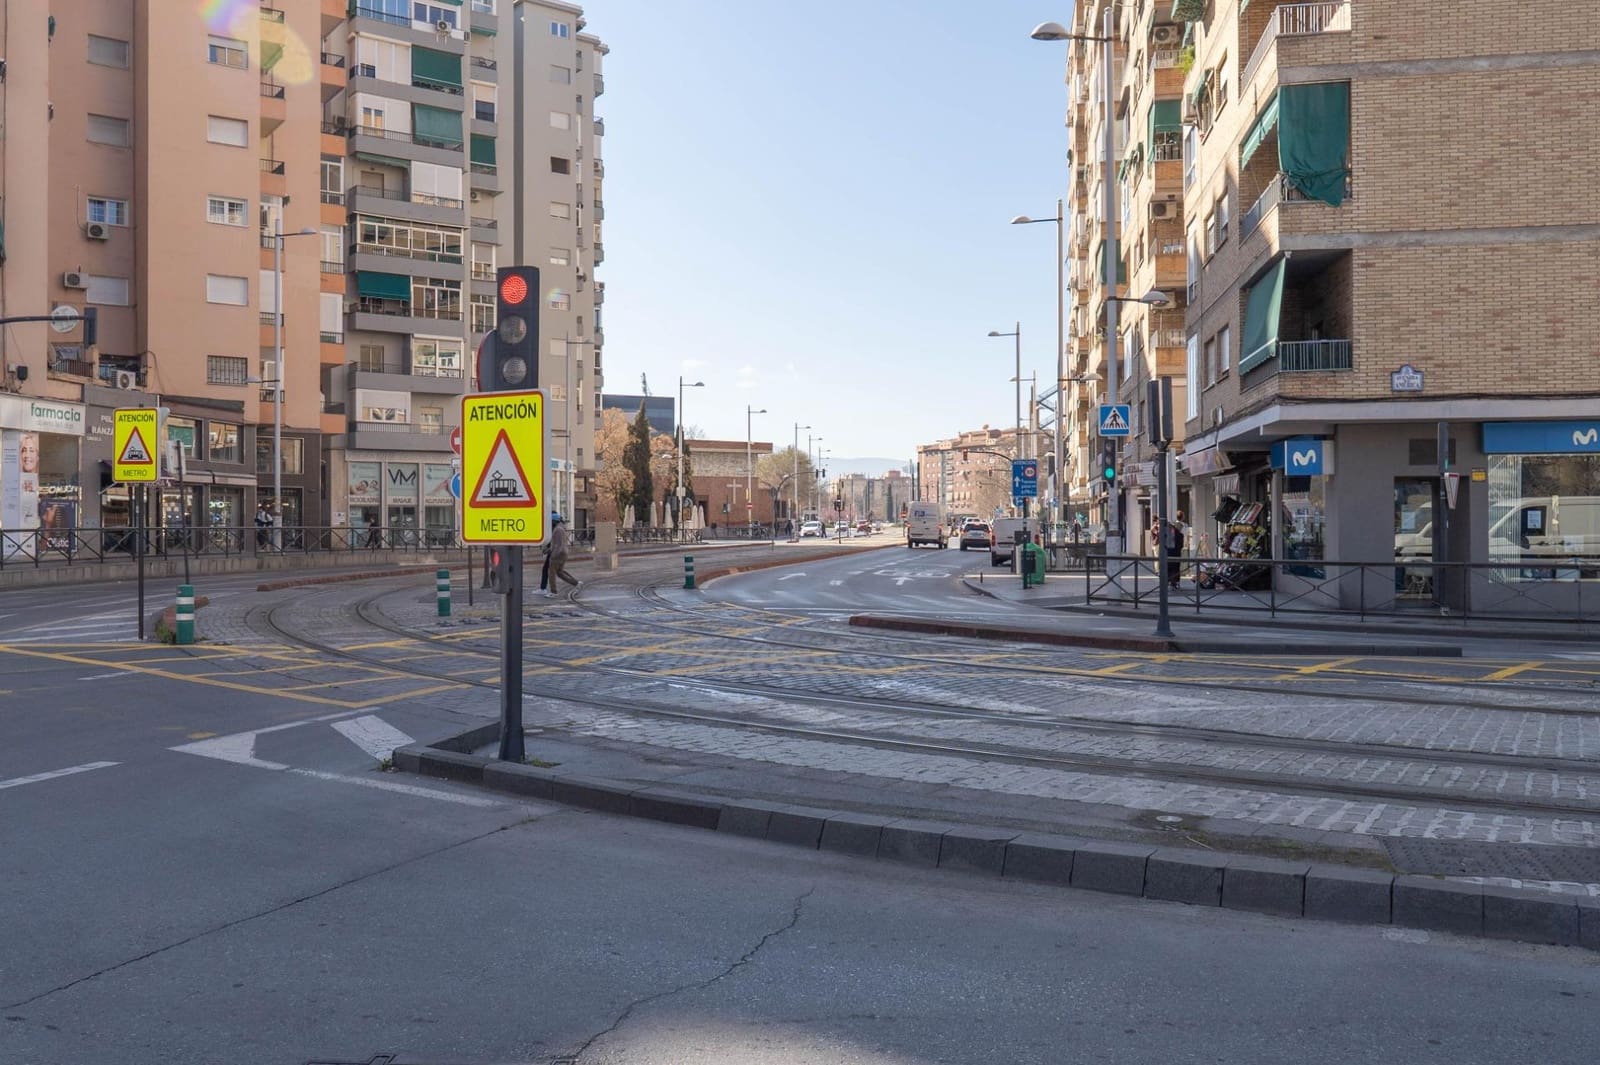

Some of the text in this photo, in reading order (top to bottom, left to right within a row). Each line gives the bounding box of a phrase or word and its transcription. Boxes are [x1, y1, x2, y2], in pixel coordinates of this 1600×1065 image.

[31, 403, 81, 421] farmacia
[469, 399, 537, 422] ATENCIÓN
[118, 414, 154, 423] ATENCIÓN
[123, 469, 147, 477] METRO
[480, 518, 526, 532] METRO
